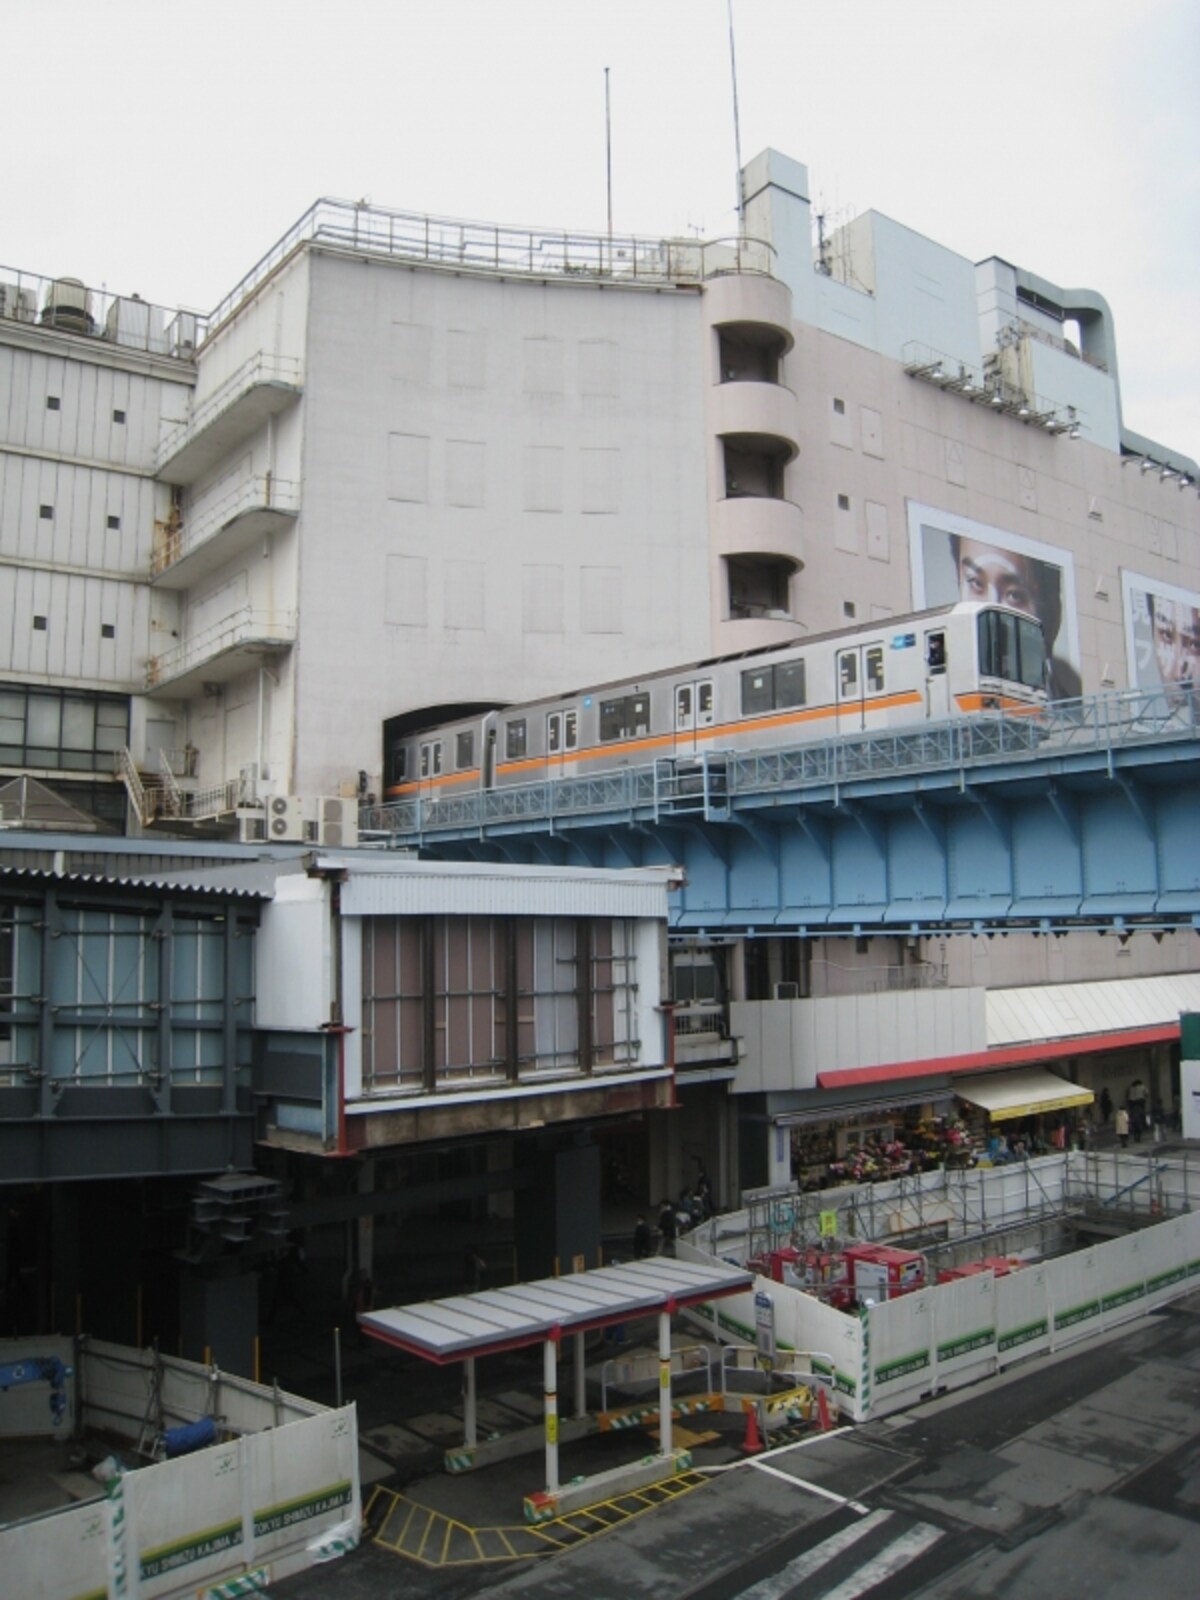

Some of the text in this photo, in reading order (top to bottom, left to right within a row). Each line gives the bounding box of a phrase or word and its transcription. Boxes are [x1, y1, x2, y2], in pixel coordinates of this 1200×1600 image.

[283, 1505, 313, 1525] SHIMIZU
[314, 1496, 344, 1514] KAJIMA
[161, 1550, 195, 1571] SHIMIZU
[197, 1537, 231, 1557] KAJIMA
